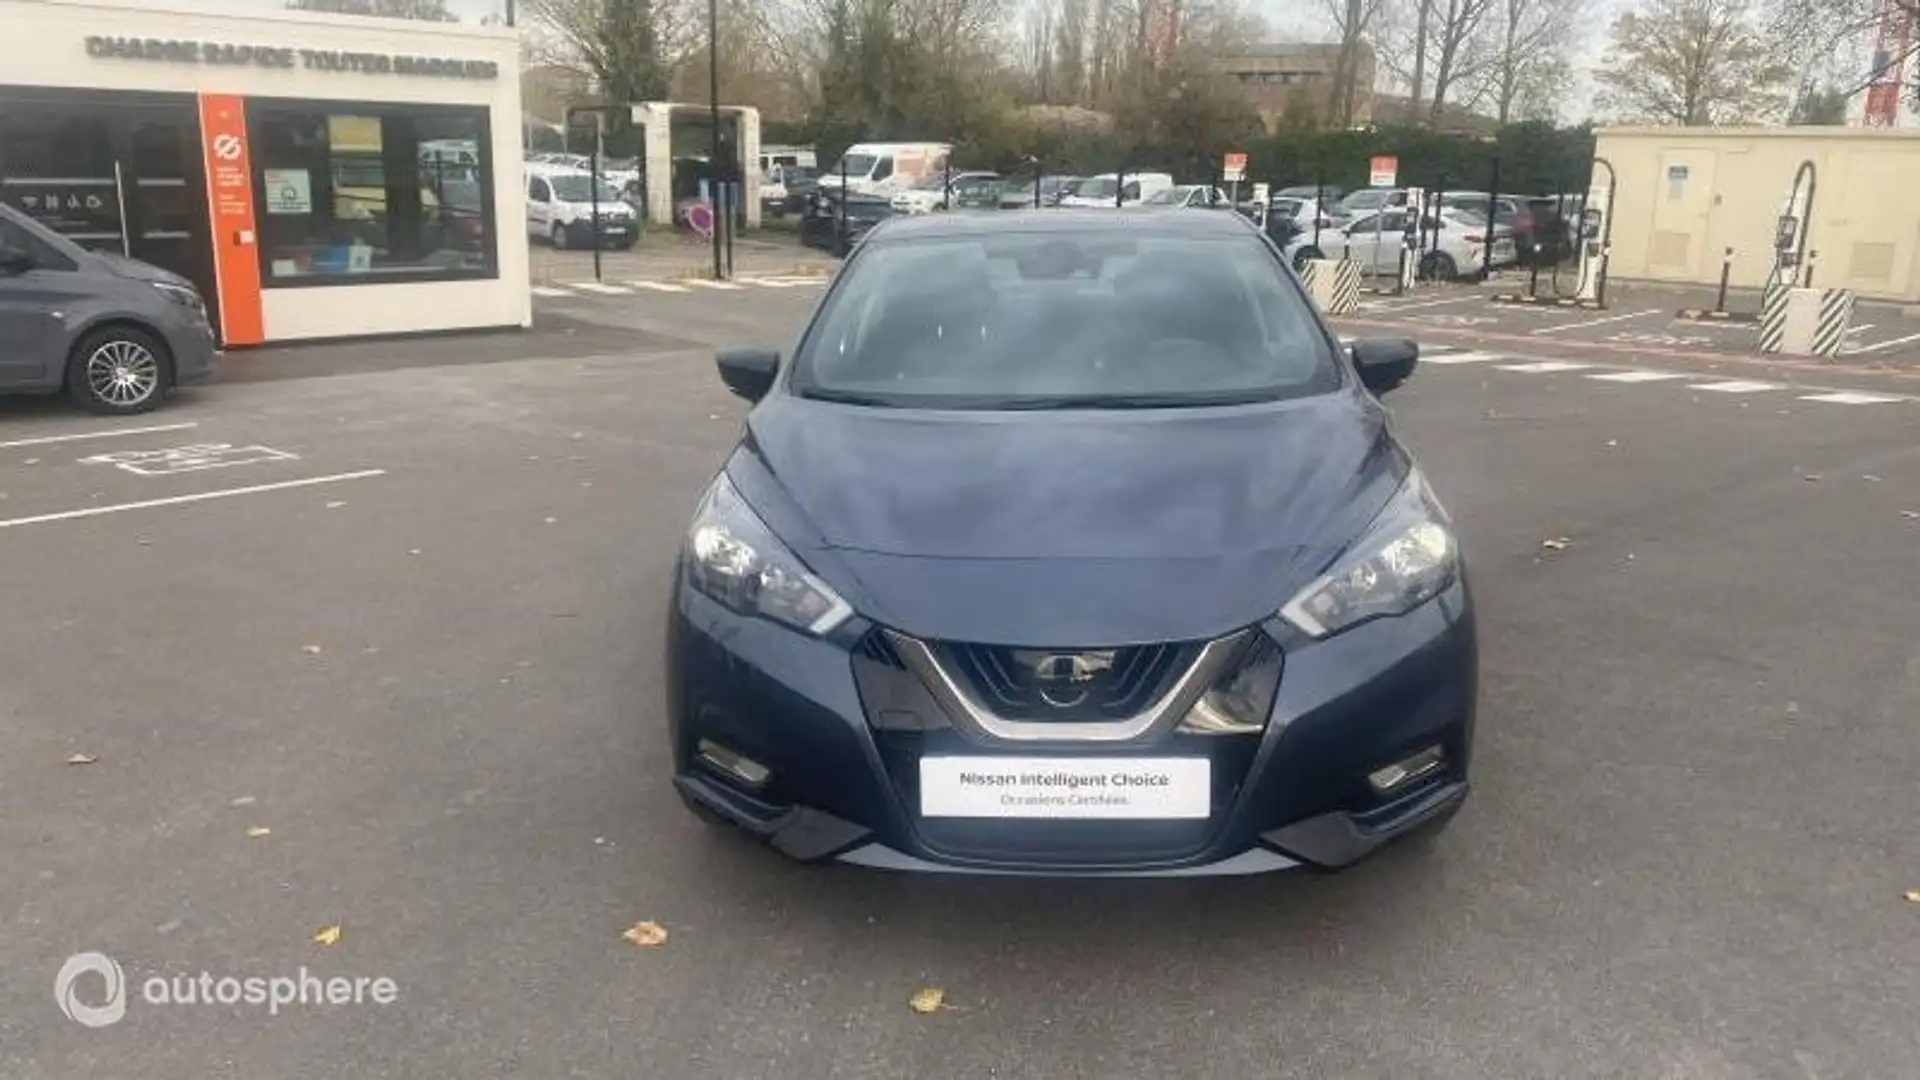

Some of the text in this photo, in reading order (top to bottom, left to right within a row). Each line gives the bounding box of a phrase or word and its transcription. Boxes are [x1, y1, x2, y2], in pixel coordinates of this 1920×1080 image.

[84, 36, 498, 79] CHARGE RAPIDE TOUTES MARQUES
[960, 773, 1169, 788] Nissan Intelligent Choice
